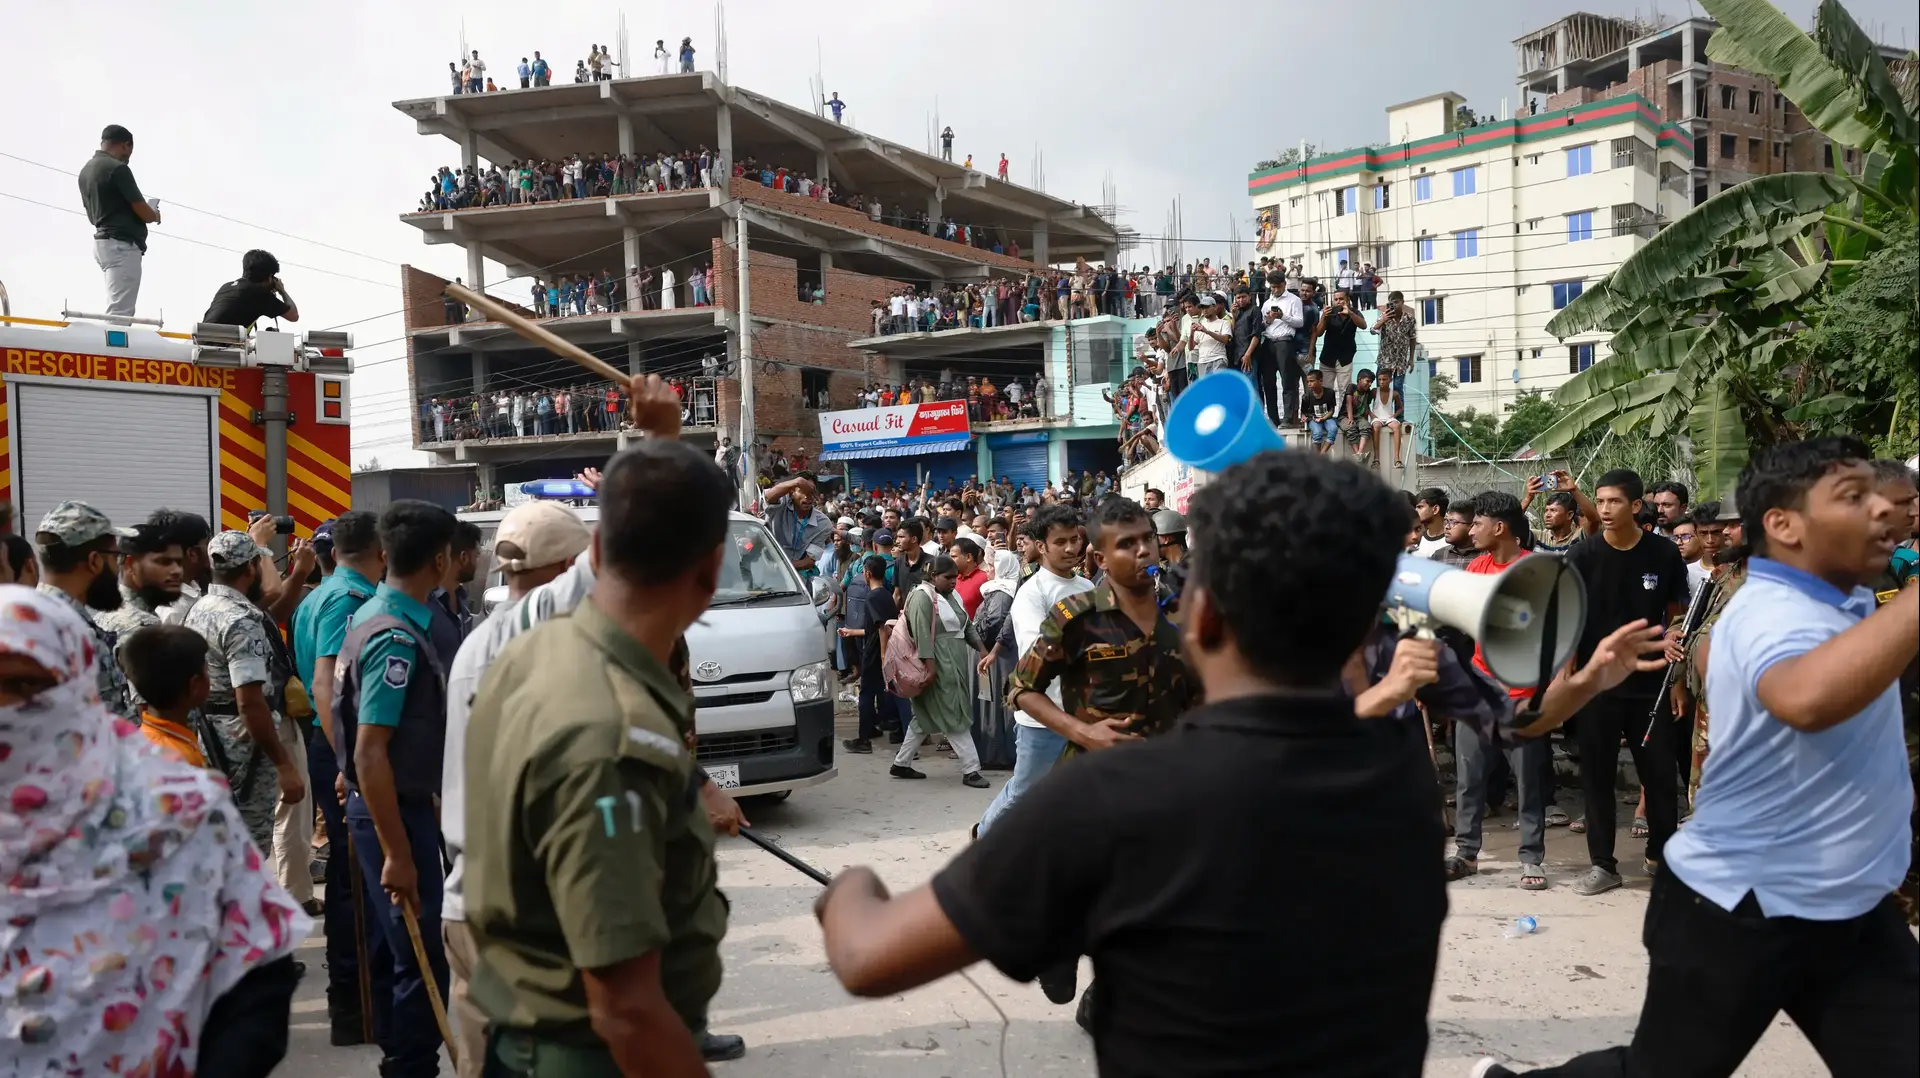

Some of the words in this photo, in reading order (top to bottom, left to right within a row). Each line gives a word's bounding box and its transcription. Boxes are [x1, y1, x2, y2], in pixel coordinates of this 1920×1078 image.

[7, 349, 108, 380] RESCUE
[115, 358, 237, 389] RESPONSE
[832, 415, 880, 434] Casual
[885, 413, 904, 429] Fit
